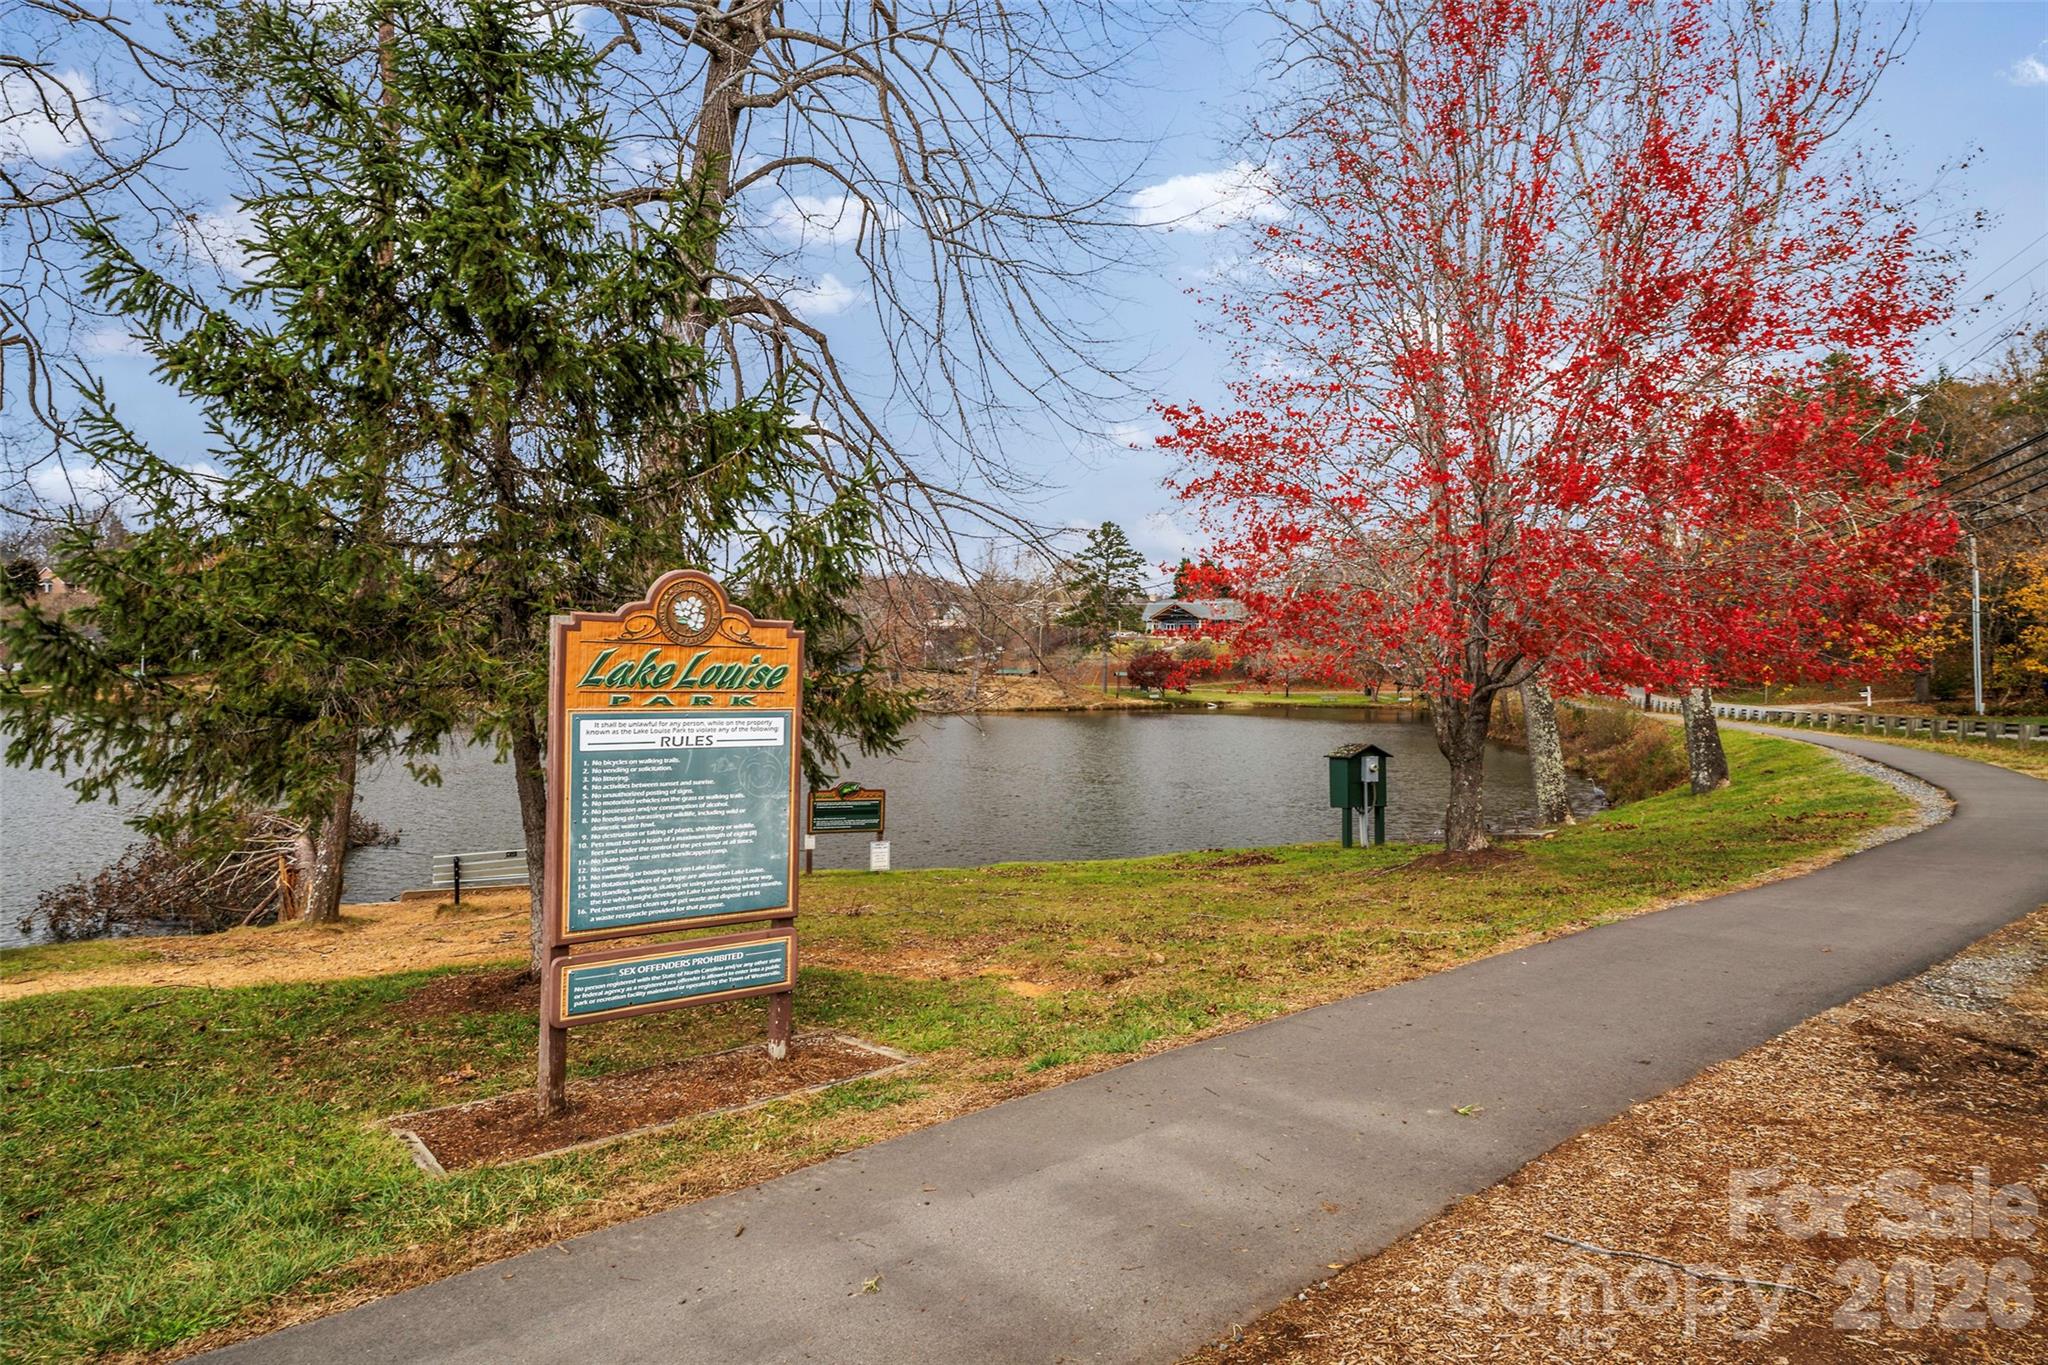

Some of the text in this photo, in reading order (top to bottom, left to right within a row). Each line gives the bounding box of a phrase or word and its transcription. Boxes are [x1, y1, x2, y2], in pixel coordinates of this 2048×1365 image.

[576, 647, 789, 690] Lake Louise
[608, 694, 757, 706] PARK
[660, 736, 714, 747] RULES
[619, 952, 744, 976] SEX OFFENDERS PROHIBITED
